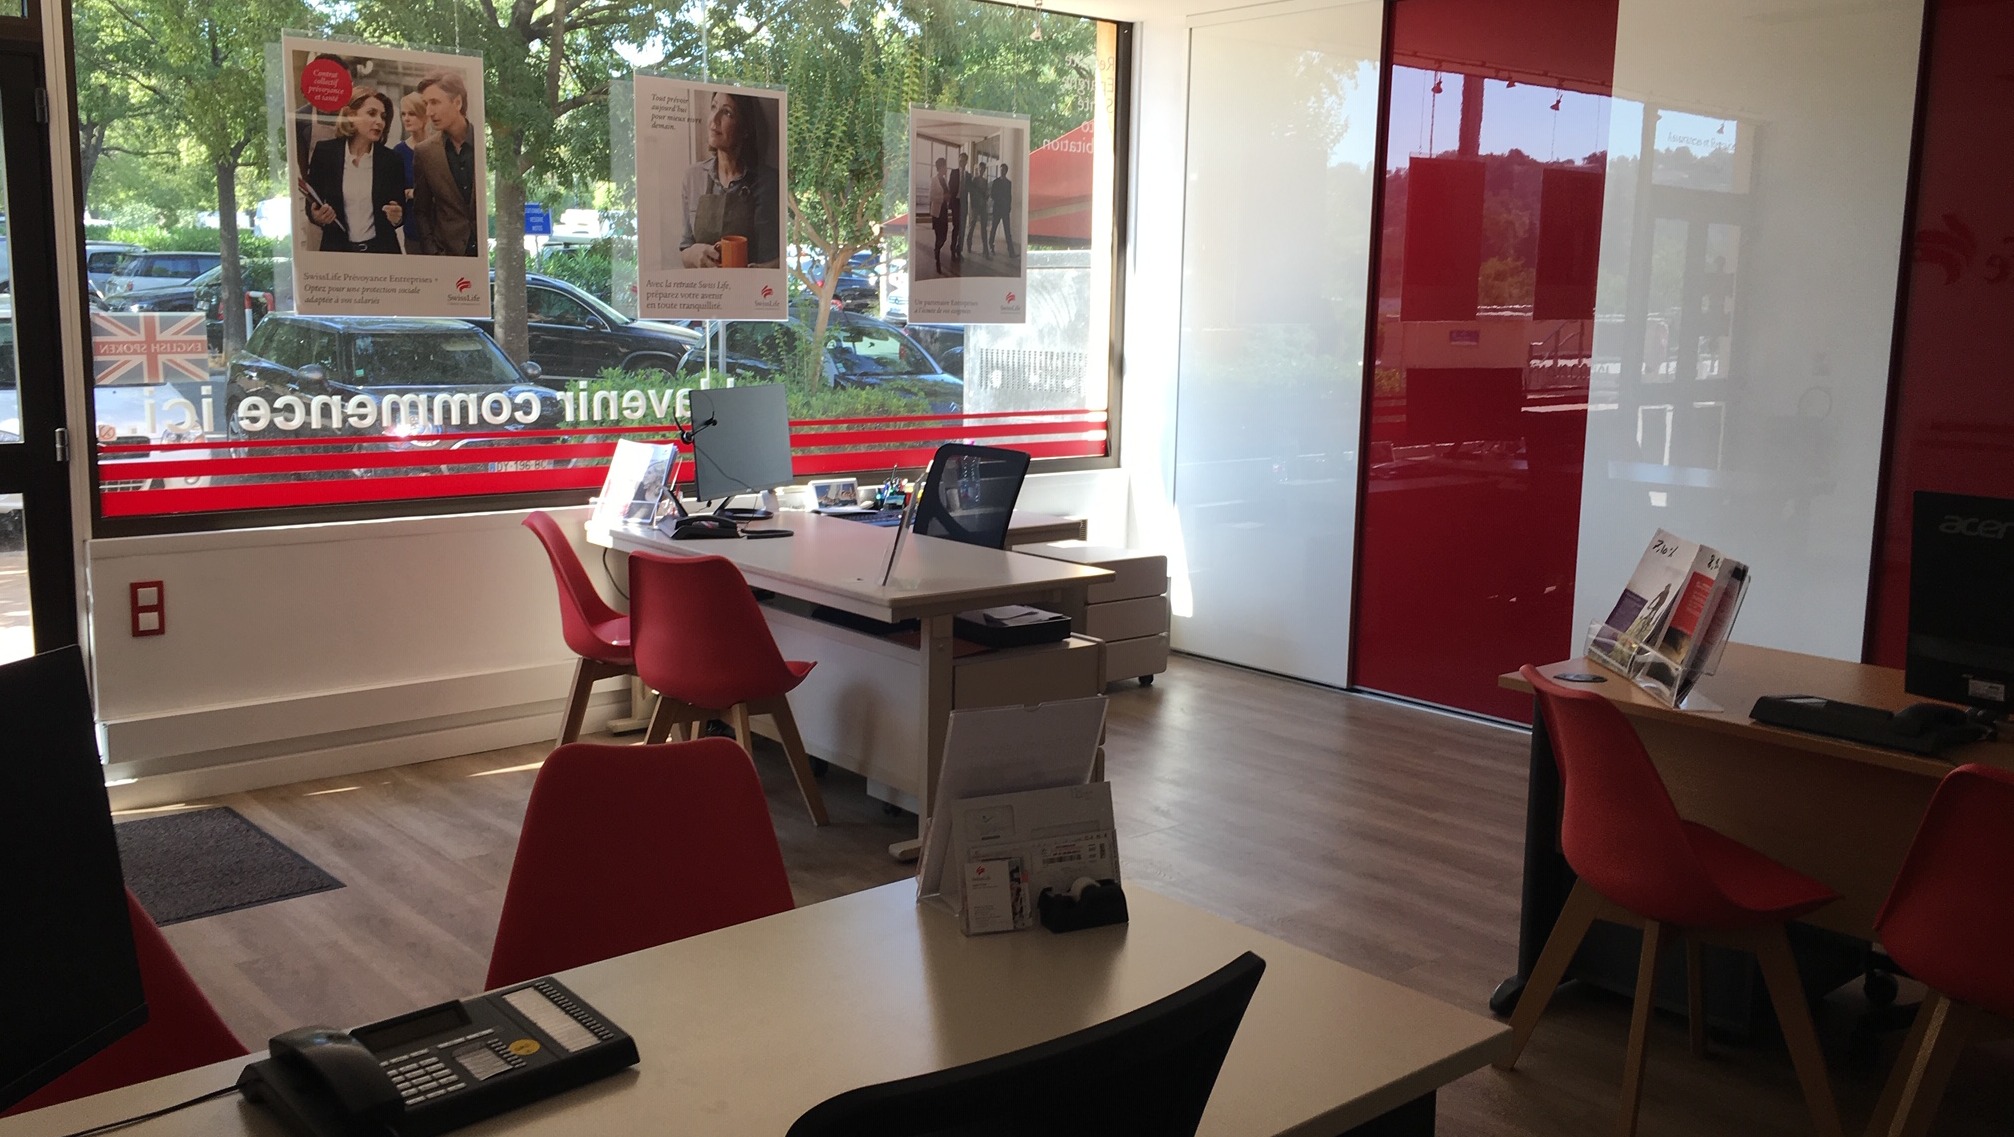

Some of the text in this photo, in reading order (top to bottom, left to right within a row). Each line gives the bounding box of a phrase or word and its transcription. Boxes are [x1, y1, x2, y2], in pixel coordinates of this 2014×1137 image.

[652, 94, 688, 104] Tout prévoir
[651, 114, 666, 122] pour
[304, 272, 341, 281] SwissLife
[344, 274, 388, 284] Prévoyance
[390, 274, 432, 284] Entreprises
[646, 280, 663, 288] Avec
[665, 280, 672, 288] la
[304, 284, 326, 294] Optez
[328, 286, 346, 294] pour
[362, 286, 397, 295] protection
[398, 286, 421, 294] sociale
[354, 296, 380, 304] salariés
[447, 294, 480, 302] SwissLife
[646, 291, 678, 300] préparez
[1939, 515, 2014, 540] acer
